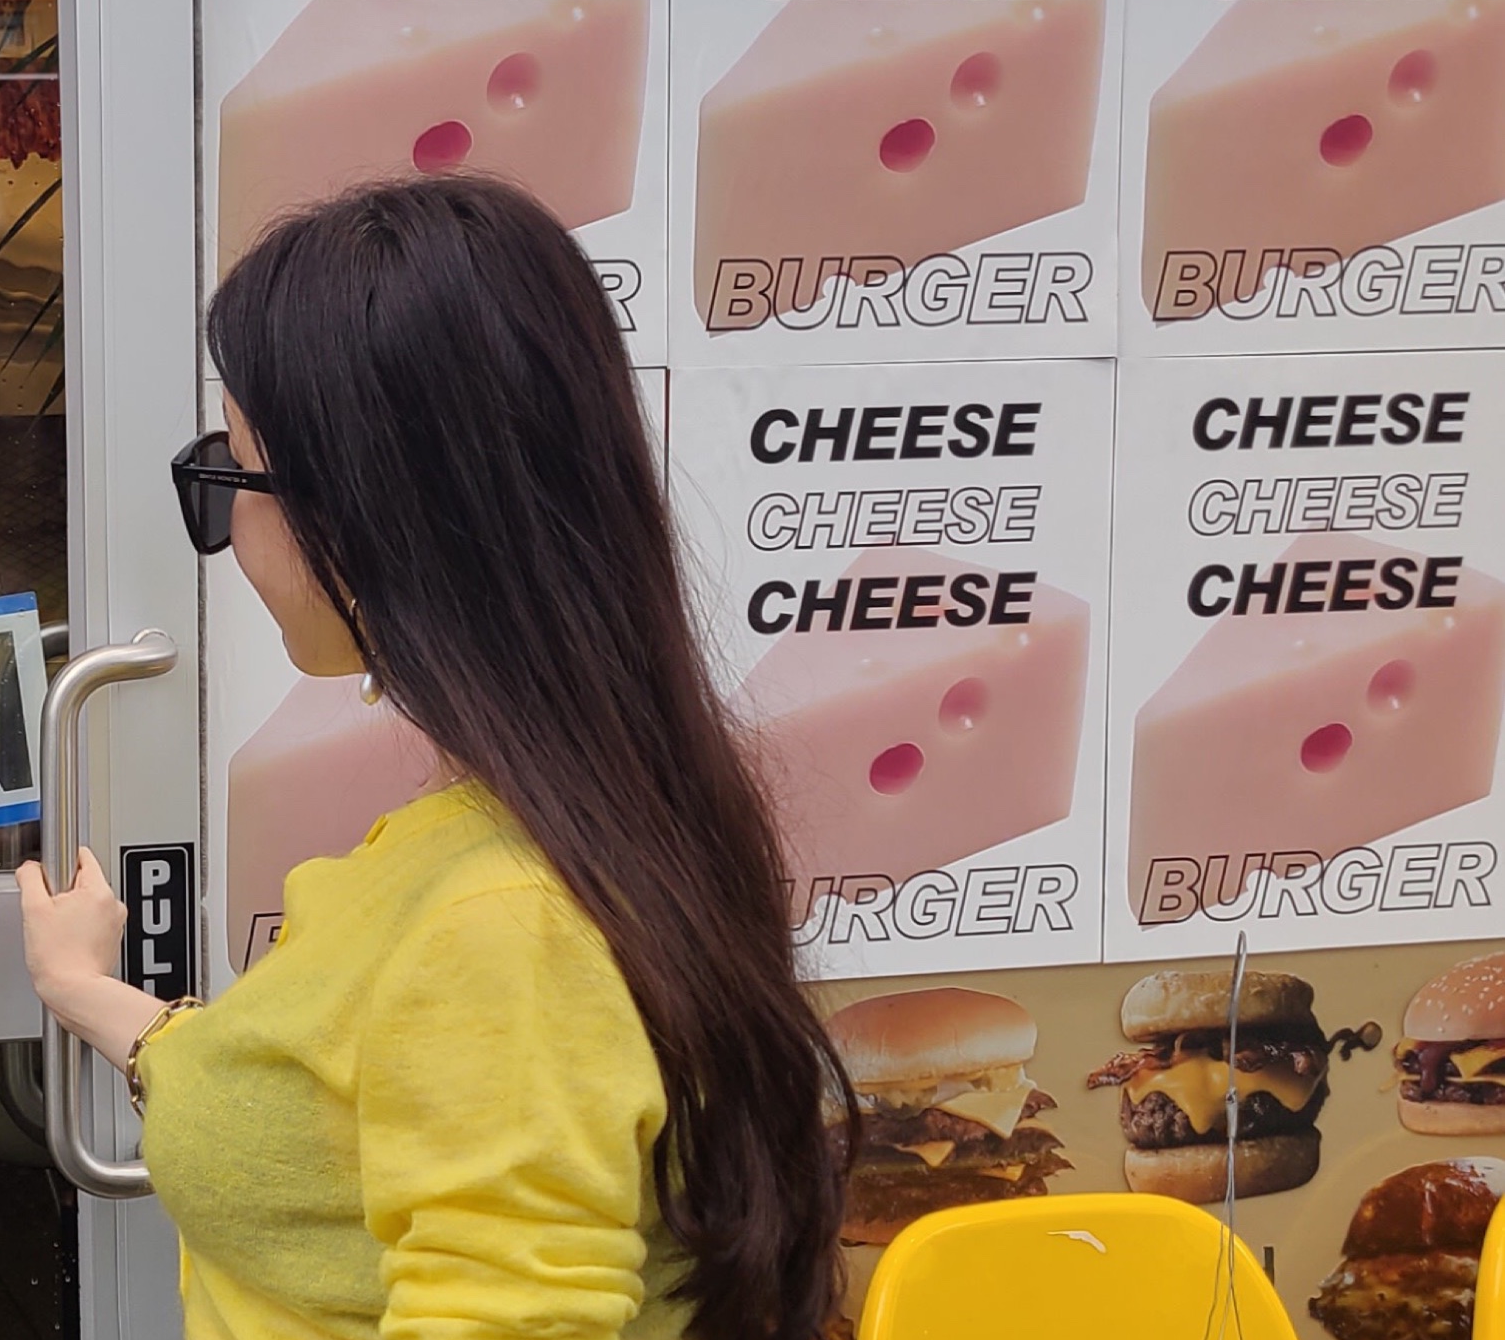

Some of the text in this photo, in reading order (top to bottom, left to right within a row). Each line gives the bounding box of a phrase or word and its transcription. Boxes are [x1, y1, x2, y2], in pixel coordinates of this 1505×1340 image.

[705, 251, 1093, 332] BURGER
[749, 402, 1042, 464] CHEESE
[1192, 391, 1470, 451] CHEESE
[746, 484, 1042, 552] CHEESE
[1187, 472, 1468, 536] CHEESE
[746, 571, 1038, 635] CHEESE
[1187, 556, 1464, 618] CHEESE
[775, 863, 1079, 948] URGER
[1138, 841, 1498, 928] BURGER
